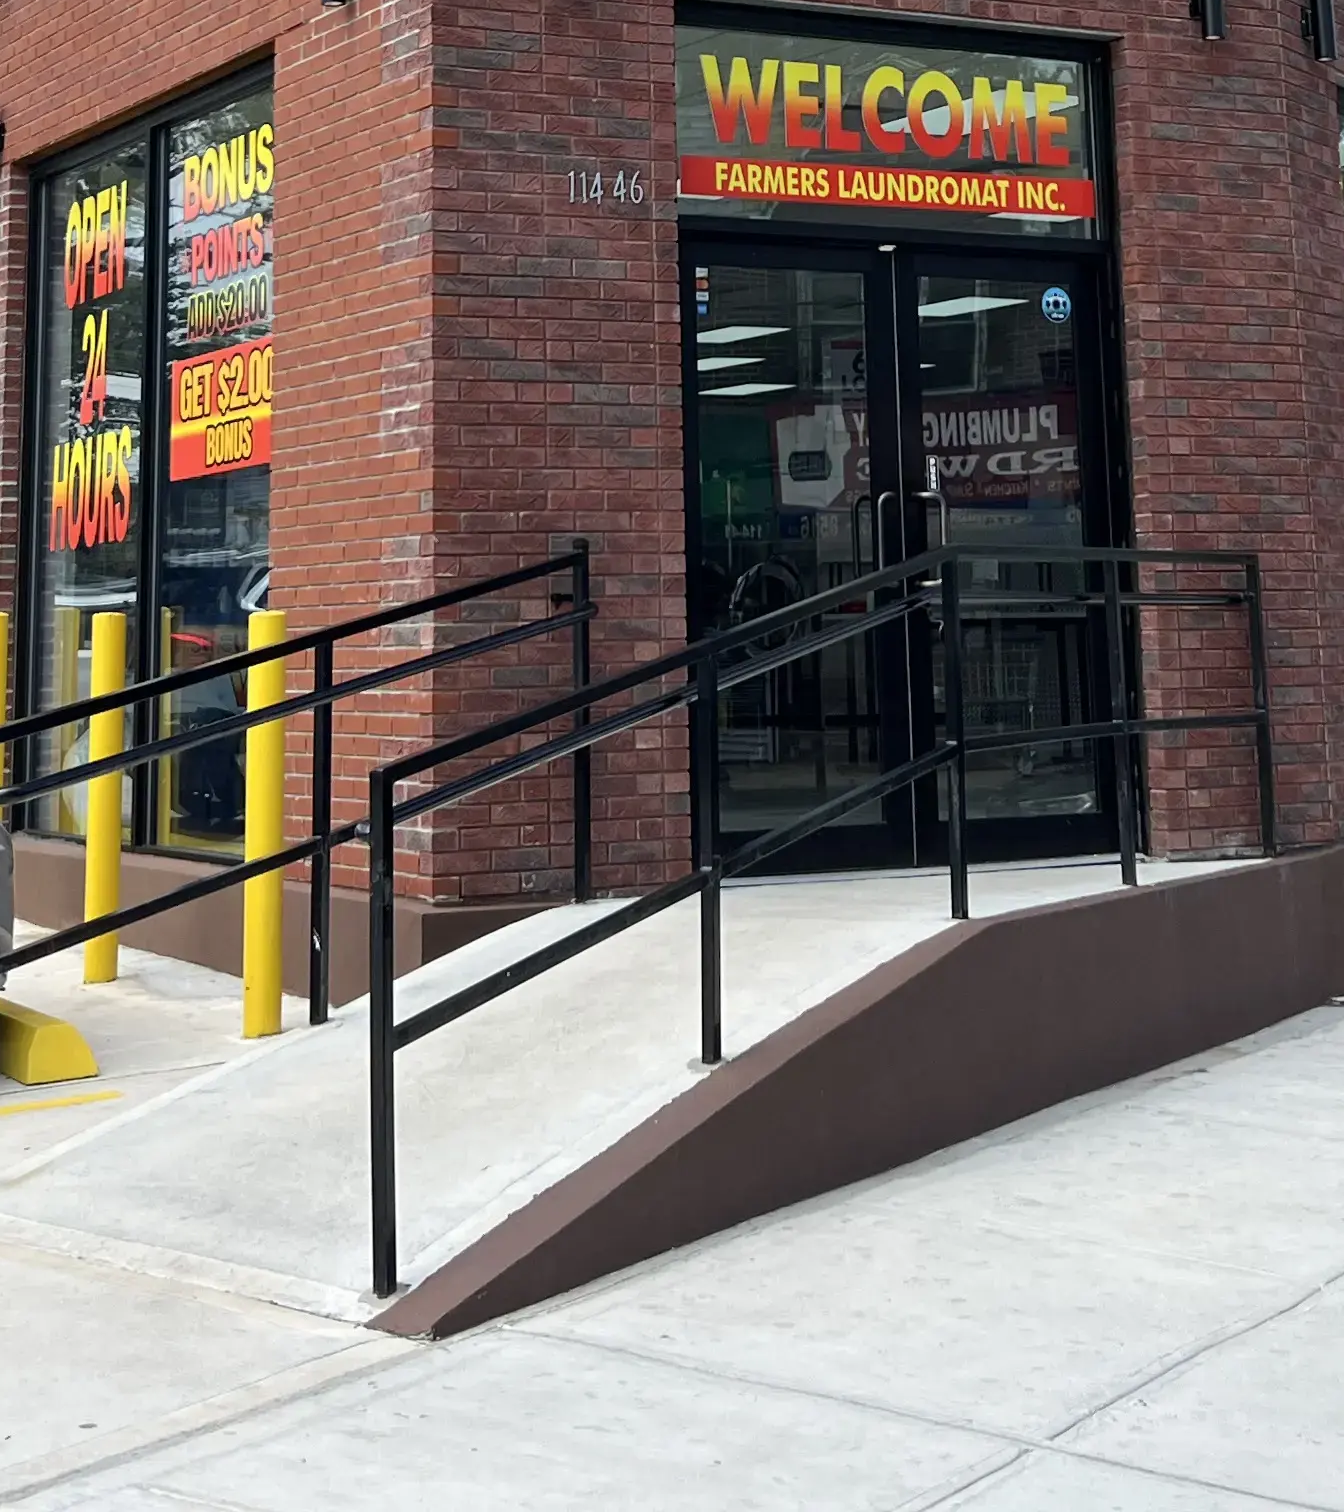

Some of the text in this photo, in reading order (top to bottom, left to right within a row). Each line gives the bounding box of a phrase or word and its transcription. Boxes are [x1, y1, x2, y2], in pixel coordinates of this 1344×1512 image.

[699, 53, 1070, 168] WELCOME
[183, 123, 274, 222] BONUS
[715, 162, 1066, 212] FARMERS LAUNDROMAT INC.
[64, 180, 128, 310] OPEN
[190, 212, 264, 288] POINTS
[186, 273, 269, 339] ADD $20.00
[80, 308, 109, 425] 24
[178, 344, 273, 422] GET $2.00
[205, 415, 254, 468] BONUS
[49, 425, 132, 553] HOURS
